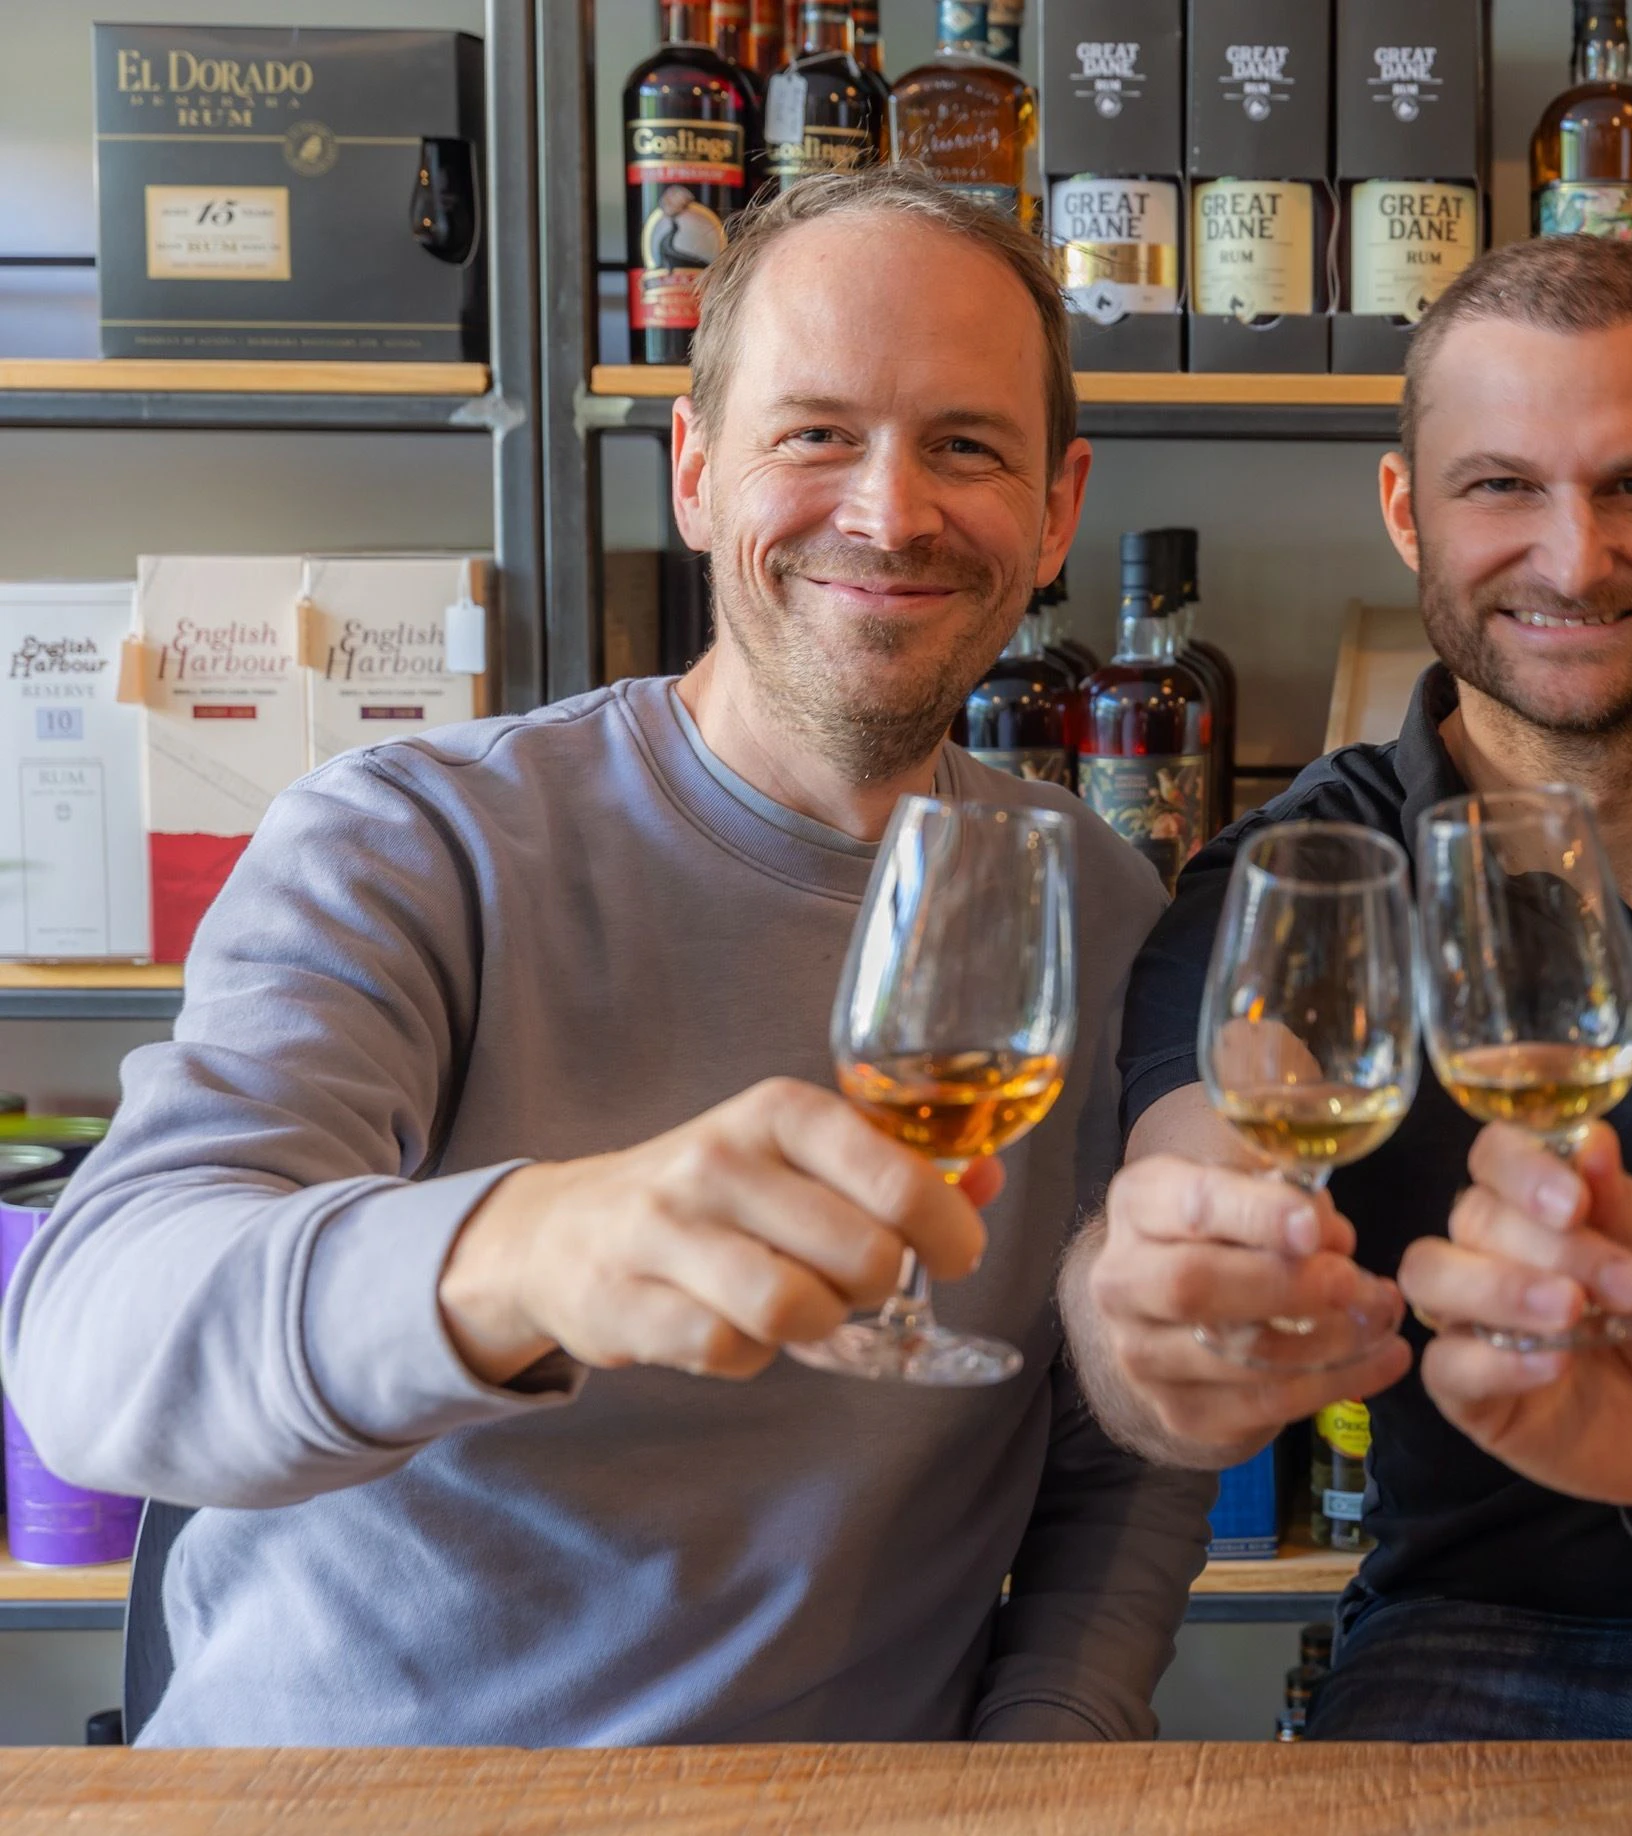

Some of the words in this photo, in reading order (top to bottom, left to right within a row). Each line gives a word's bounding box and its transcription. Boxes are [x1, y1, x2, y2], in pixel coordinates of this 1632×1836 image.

[1076, 42, 1141, 62] GREAT
[1225, 45, 1290, 65] GREAT
[1373, 47, 1438, 66] GREAT
[117, 49, 161, 92] EL
[168, 49, 314, 98] DORADO
[1083, 59, 1135, 77] DANE
[1232, 62, 1284, 80] DANE
[1380, 64, 1432, 81] DANE
[177, 107, 253, 128] RUM
[632, 127, 734, 162] Goslings
[197, 199, 237, 227] 15
[1063, 191, 1151, 215] GREAT
[1201, 192, 1283, 216] GREAT
[1379, 193, 1464, 219] GREAT
[1072, 217, 1143, 239] DANE
[1206, 217, 1275, 240] DANE
[1388, 218, 1458, 242] DANE
[1219, 249, 1254, 263] RUM
[1406, 250, 1442, 265] RUM
[172, 616, 277, 651] English
[340, 618, 445, 653] English
[20, 634, 98, 658] English
[8, 651, 110, 678] Harbour
[157, 643, 293, 680] Harbour
[325, 643, 446, 680] Harbou
[46, 710, 73, 732] 10
[38, 769, 86, 785] RUM
